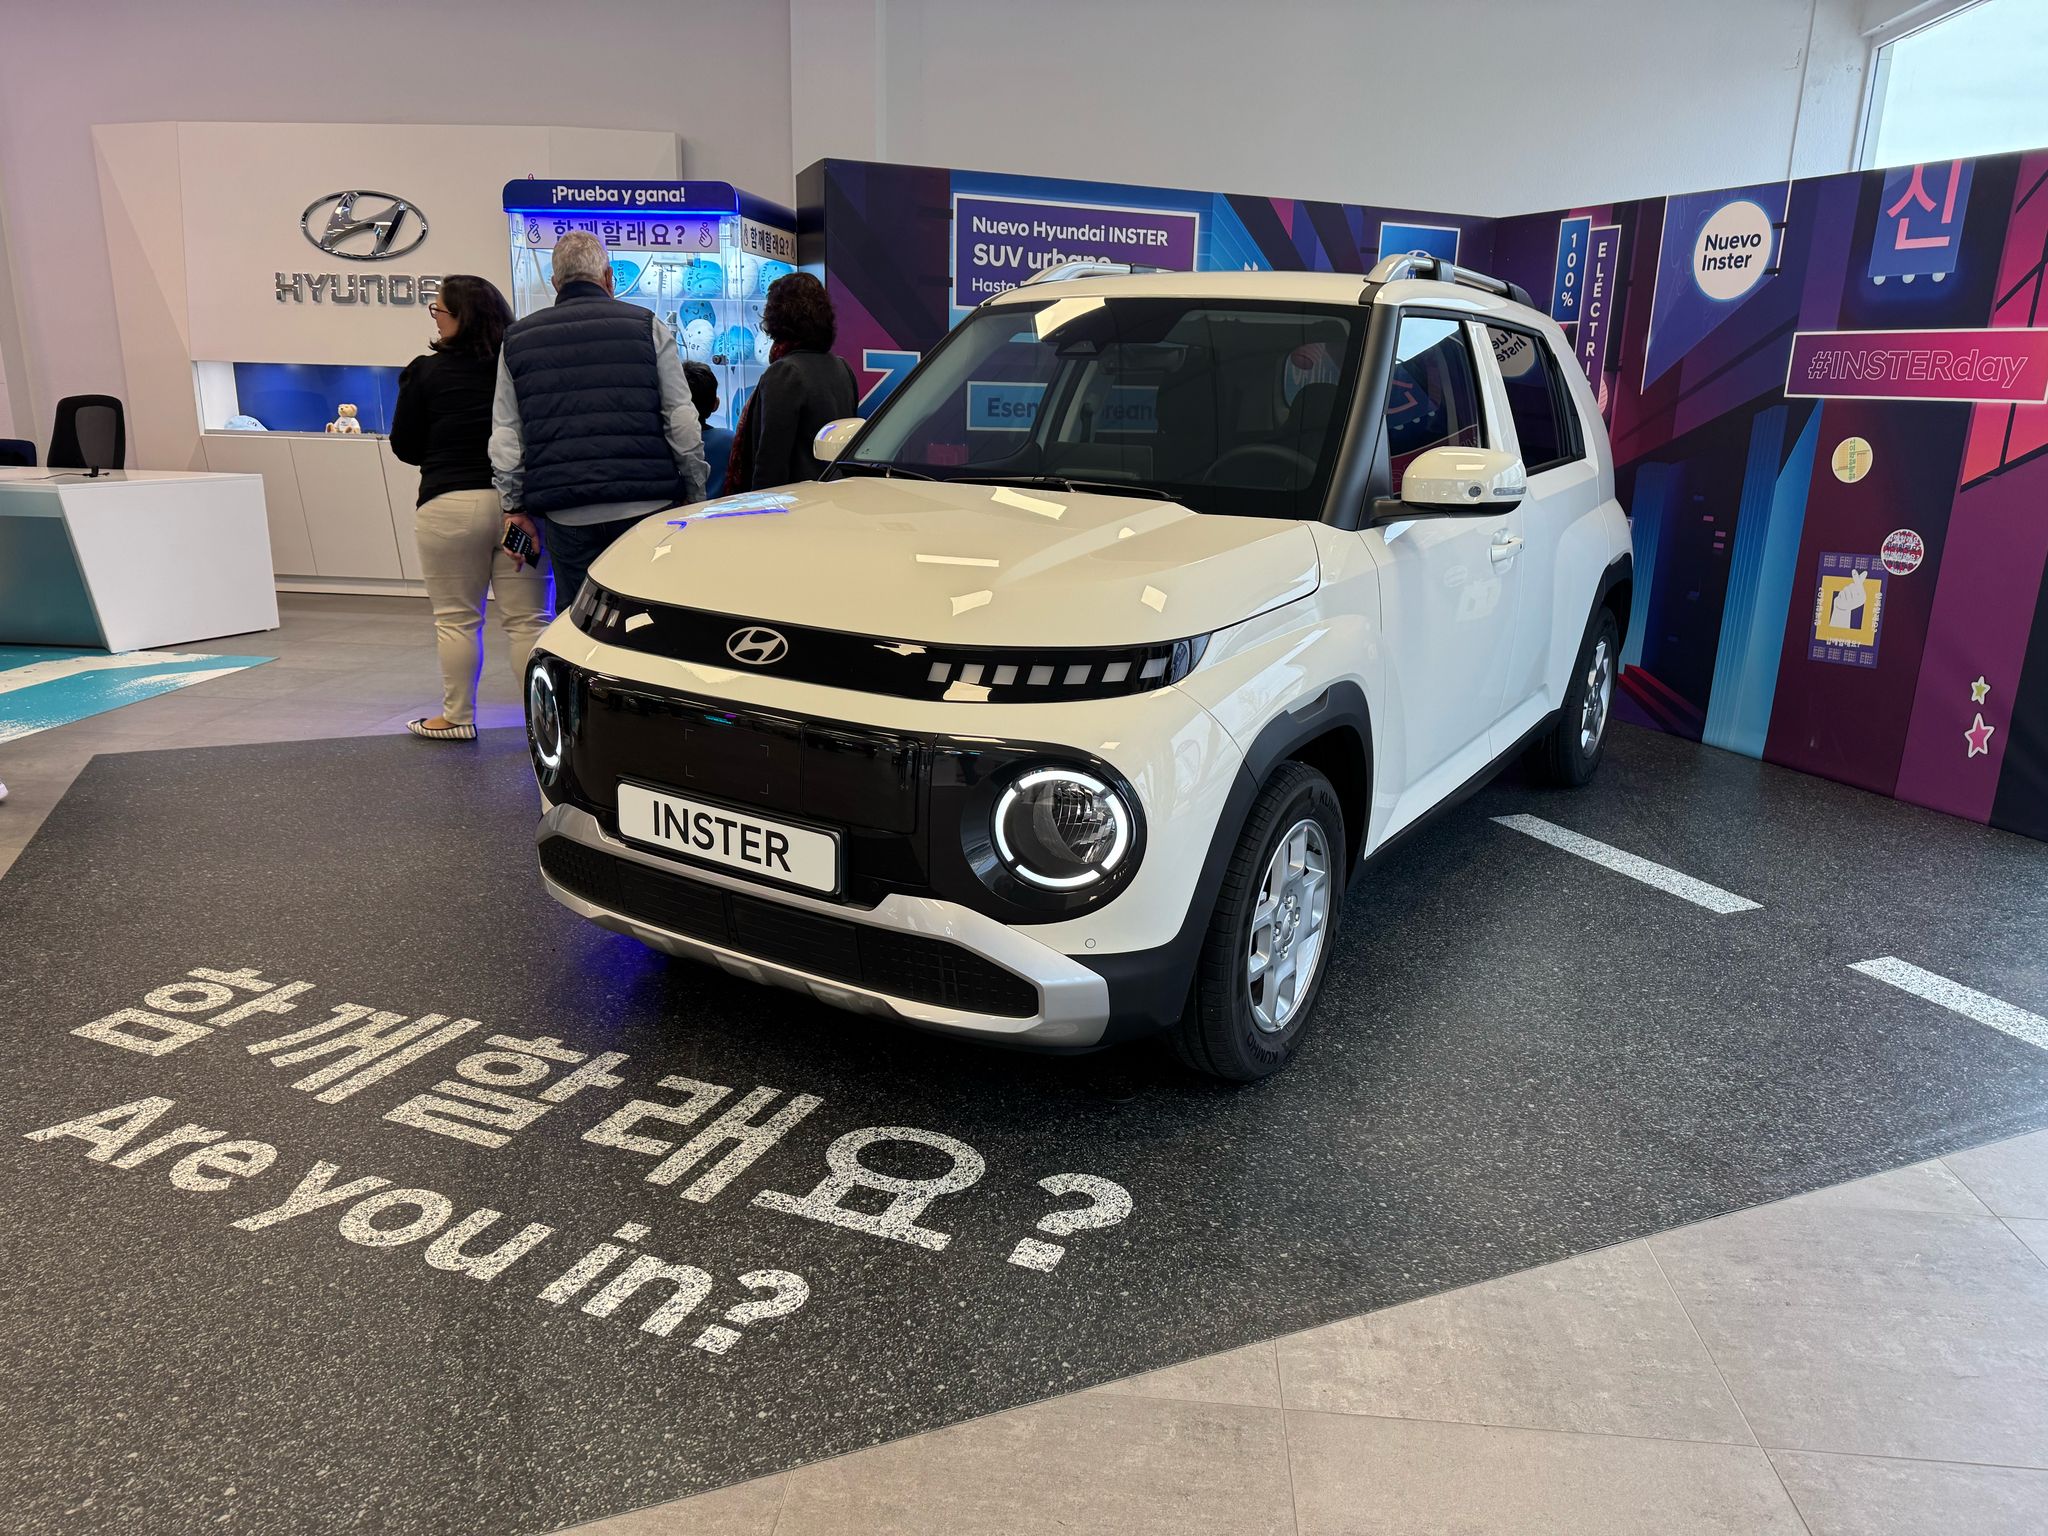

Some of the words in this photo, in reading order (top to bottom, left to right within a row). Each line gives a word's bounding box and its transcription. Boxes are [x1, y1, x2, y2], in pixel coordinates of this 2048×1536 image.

[552, 185, 619, 203] ¡Prueba
[621, 190, 632, 205] y
[635, 187, 686, 205] gana!
[972, 216, 1029, 237] Nuevo
[1033, 221, 1105, 242] Hyundai
[1109, 227, 1169, 247] INSTER
[1704, 231, 1762, 253] Nuevo
[973, 243, 1024, 268] SUV
[1561, 232, 1577, 307] 100%
[1701, 252, 1753, 272] Inster
[275, 272, 444, 305] HYUNDA
[972, 277, 1018, 293] Hasta
[1585, 242, 1608, 382] ELÉCTRI
[1808, 348, 2029, 389] #INSTERday
[987, 397, 1039, 418] Esen
[653, 800, 792, 873] INSTER
[23, 1096, 279, 1193] Are
[229, 1159, 556, 1282] you
[536, 1220, 811, 1355] in?
